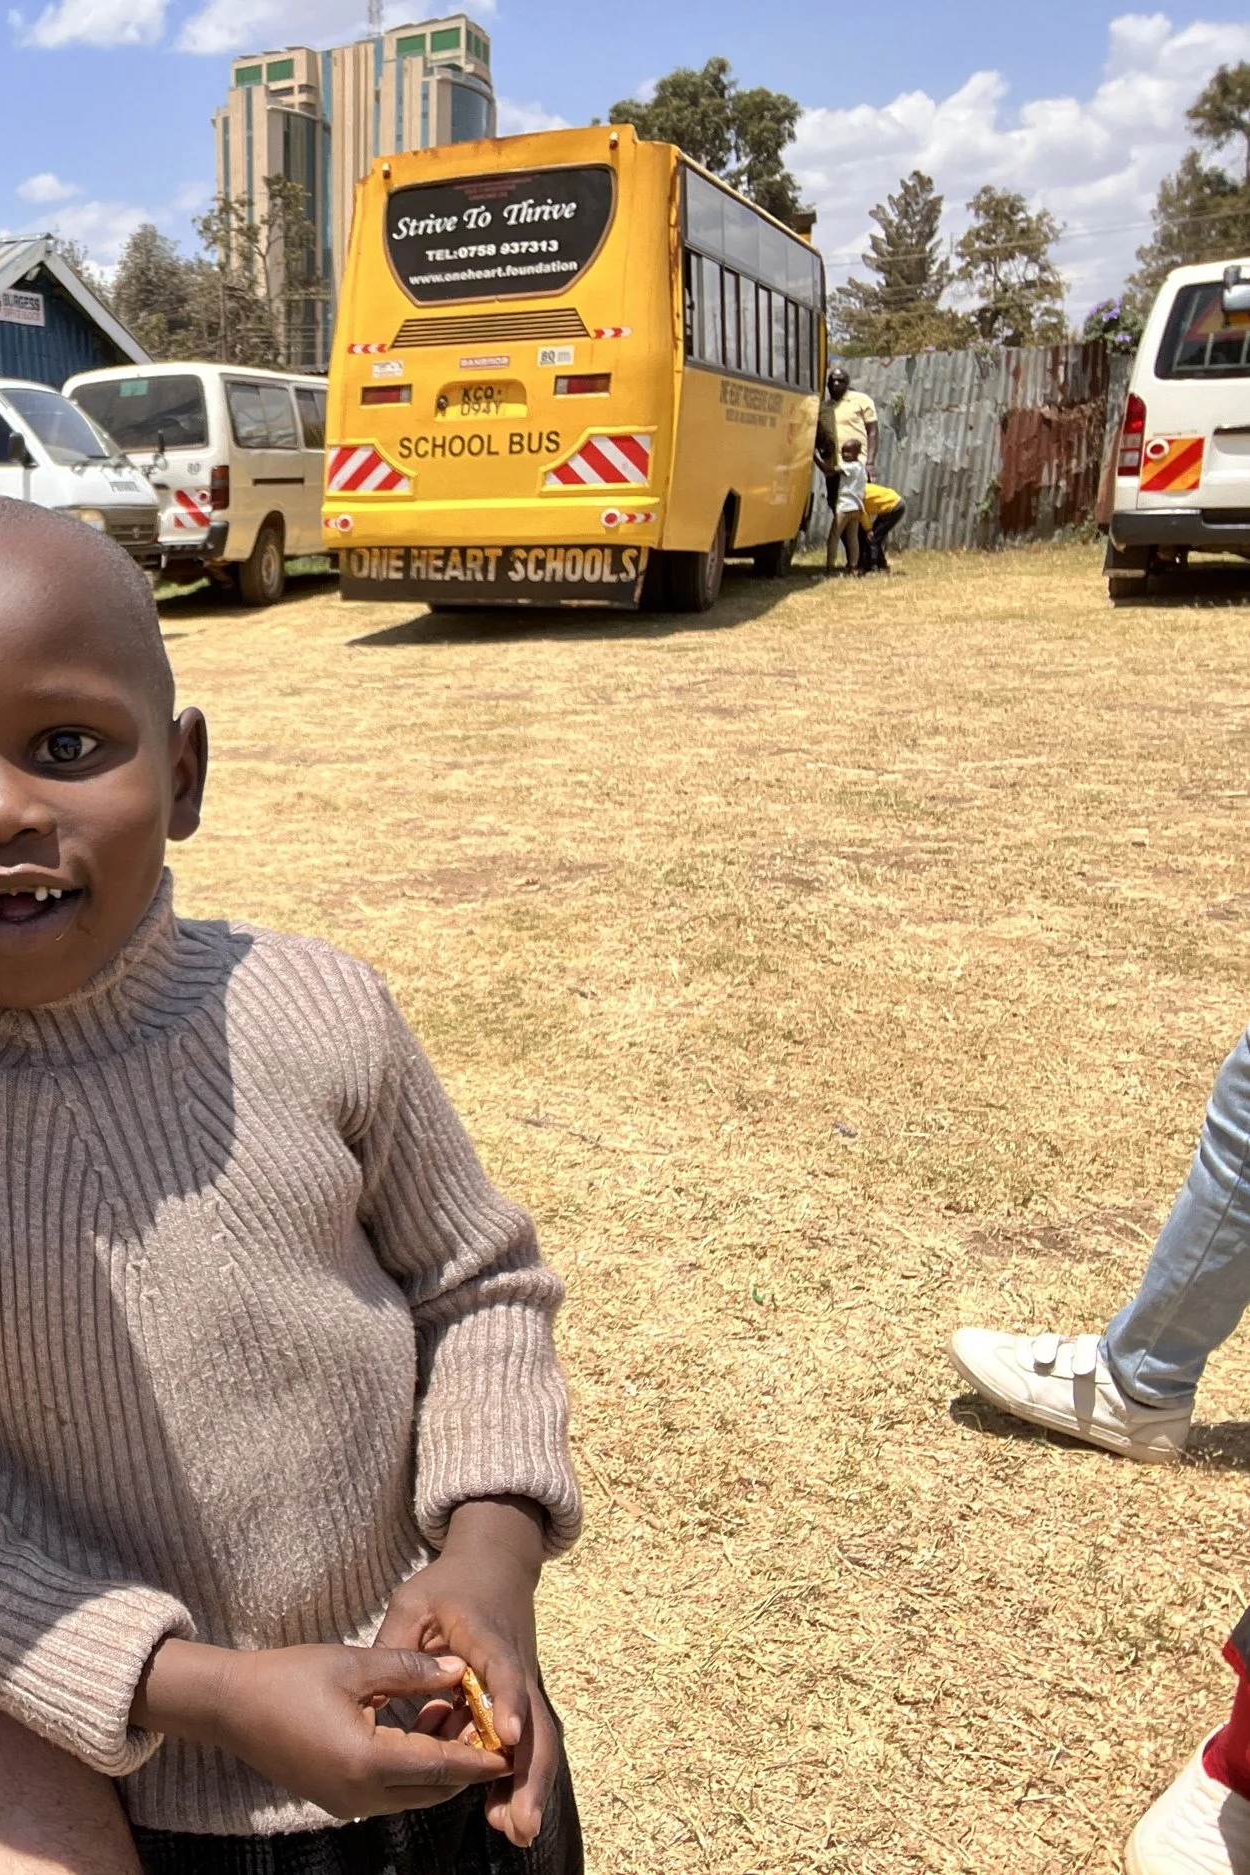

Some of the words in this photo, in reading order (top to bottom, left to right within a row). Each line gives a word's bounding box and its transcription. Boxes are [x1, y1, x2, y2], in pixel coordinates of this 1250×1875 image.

[392, 213, 458, 240] Strive
[463, 205, 492, 230] To
[503, 198, 577, 226] Thrive
[500, 239, 560, 256] 937313
[408, 260, 578, 286] www.oneheart.foundation
[398, 433, 499, 459] SCHOOL
[508, 431, 560, 454] BUS
[351, 548, 404, 580] ONE
[410, 548, 502, 581] HEART
[508, 547, 639, 582] SCHOOLS
